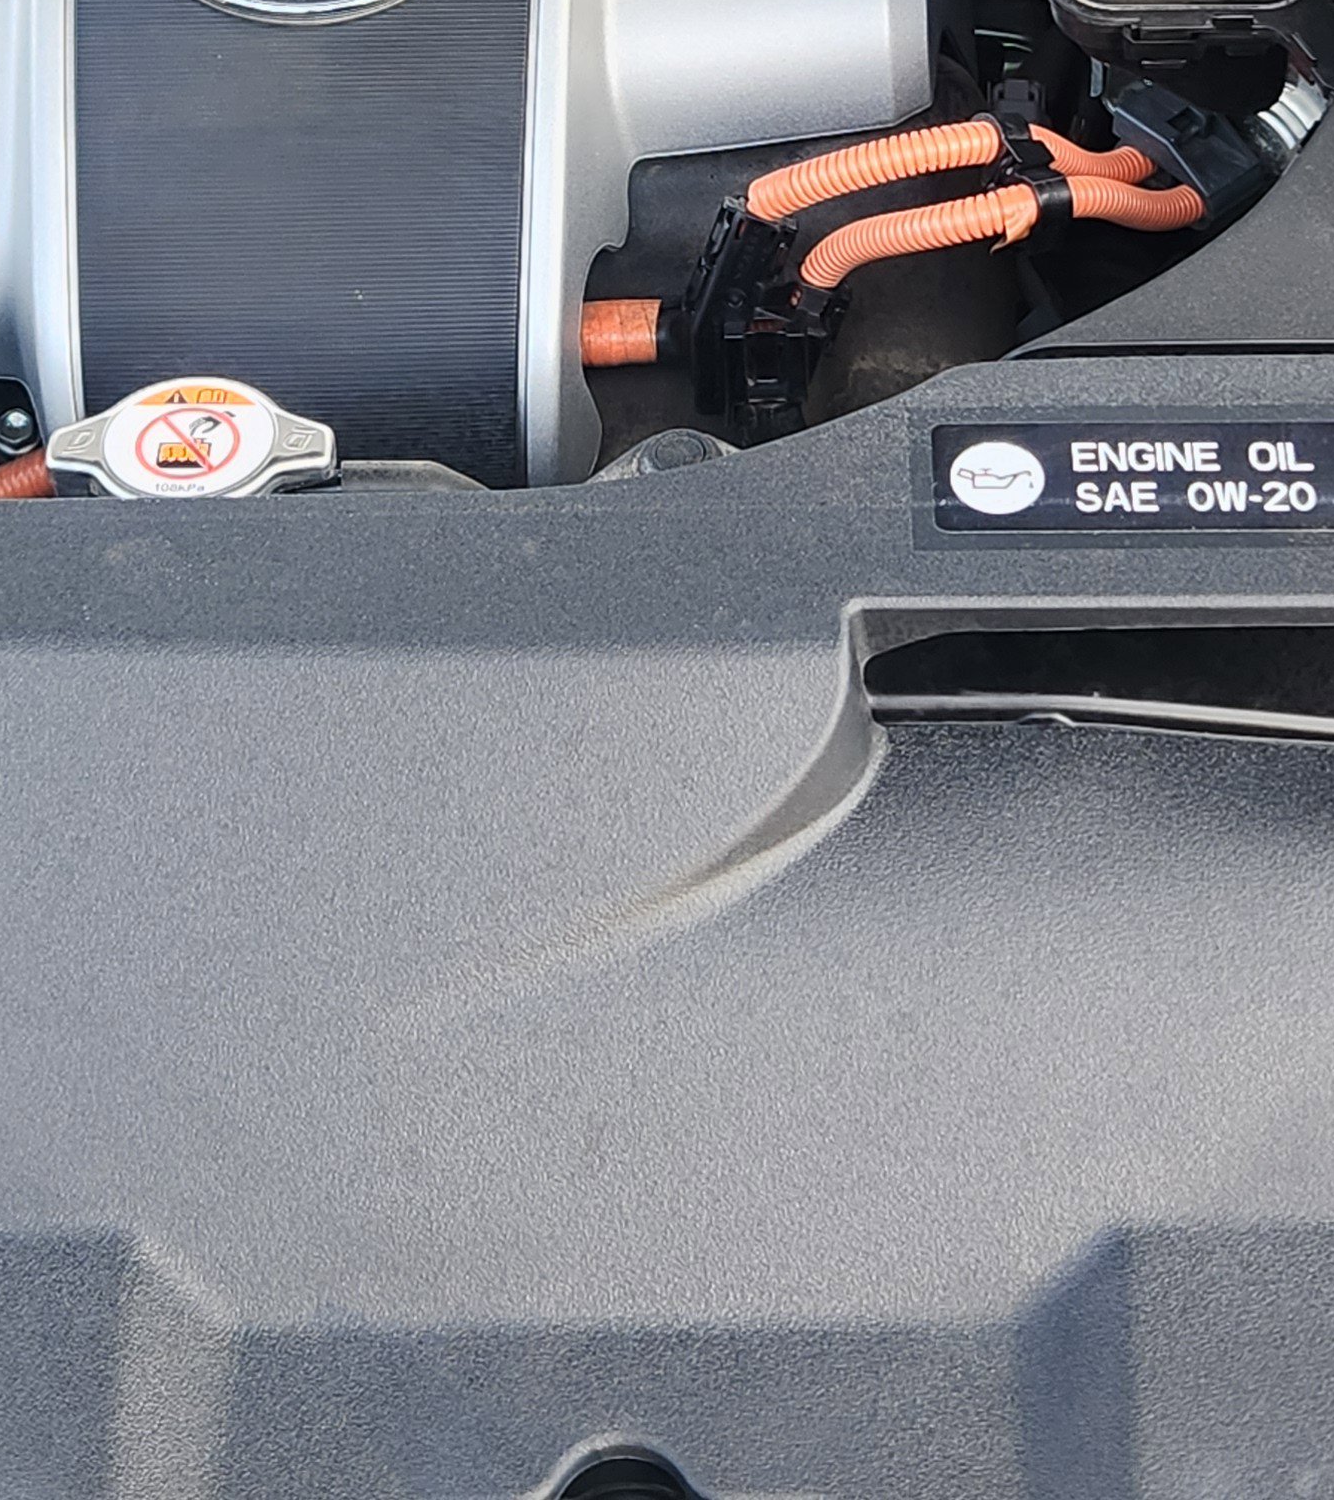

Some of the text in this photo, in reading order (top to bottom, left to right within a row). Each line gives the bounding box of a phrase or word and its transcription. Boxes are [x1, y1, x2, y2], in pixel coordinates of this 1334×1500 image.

[1070, 440, 1315, 473] ENGINE OIL
[1075, 481, 1317, 513] SAE 0W-20
